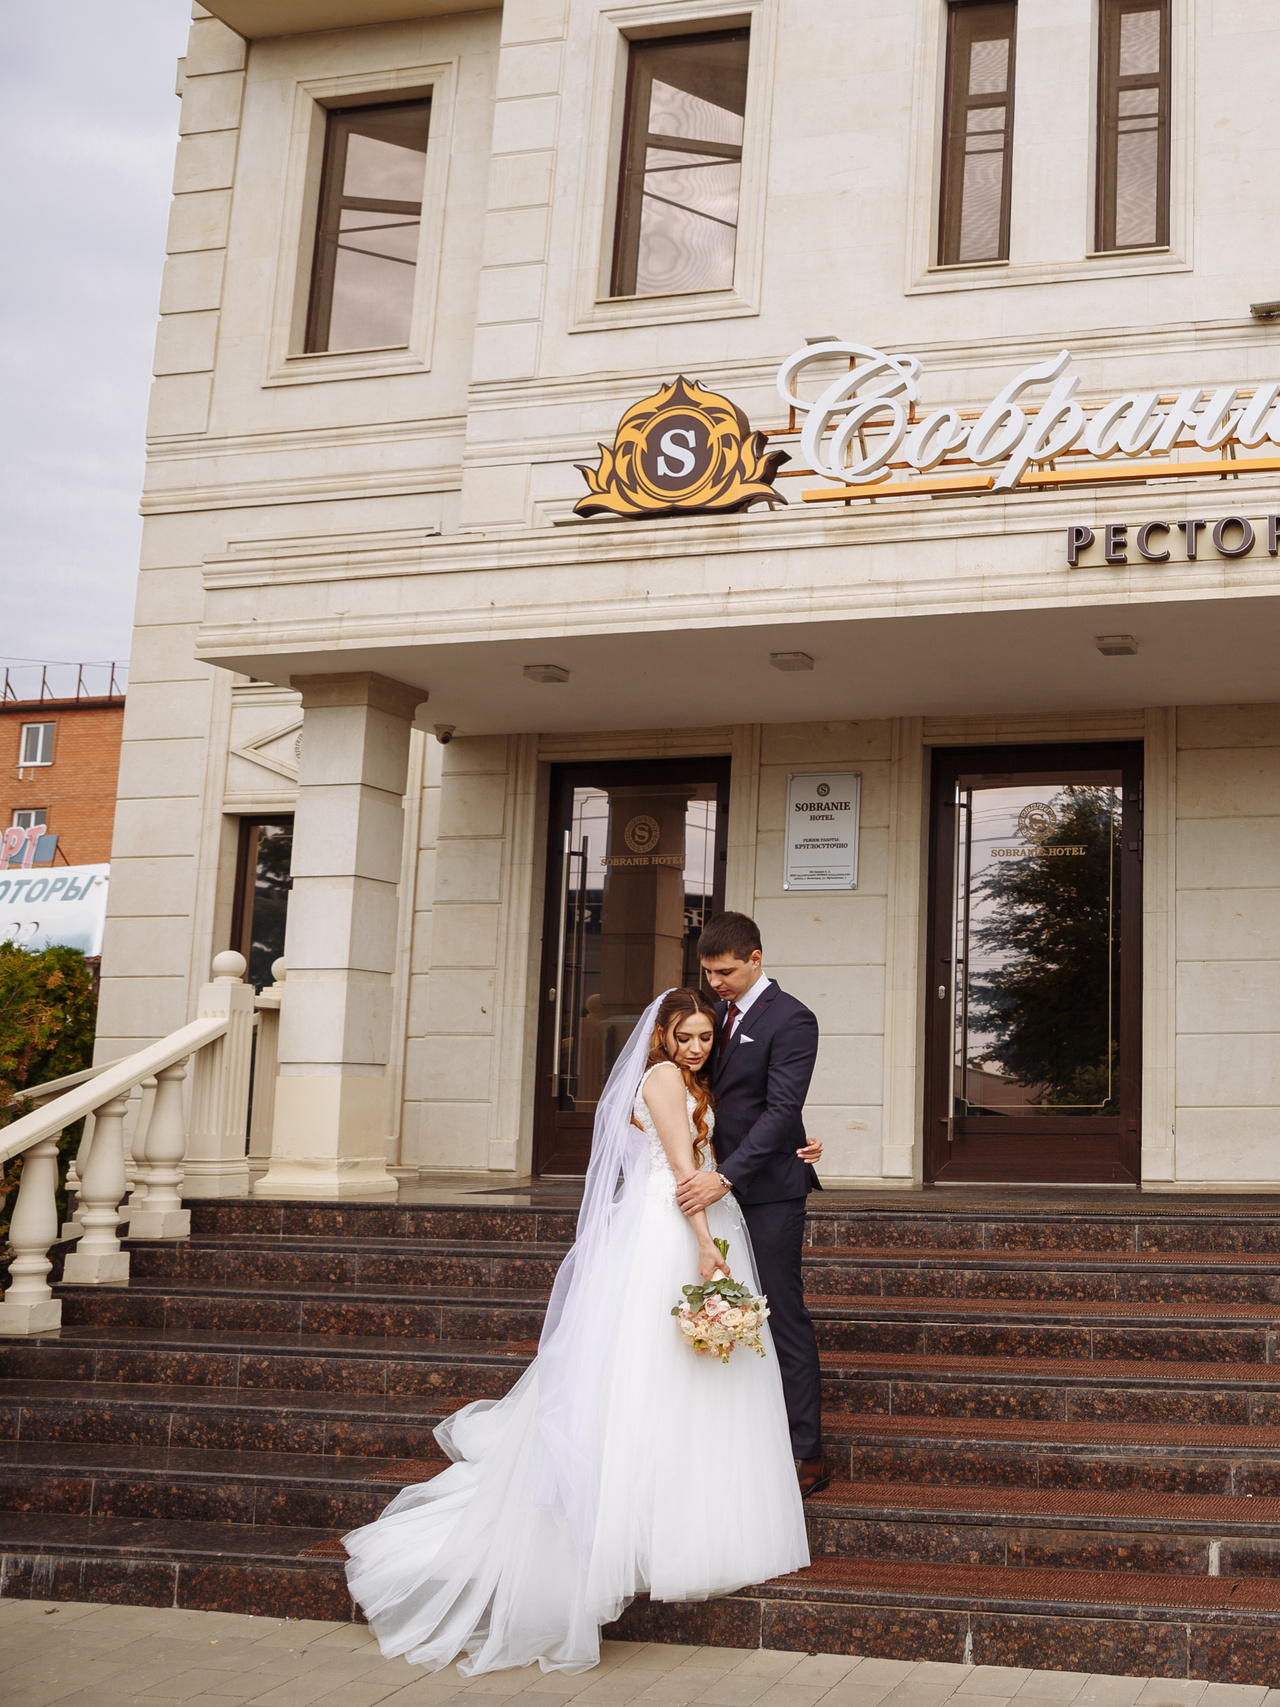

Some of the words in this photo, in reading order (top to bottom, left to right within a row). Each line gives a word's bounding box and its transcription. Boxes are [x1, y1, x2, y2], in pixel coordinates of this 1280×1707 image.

[657, 428, 697, 478] S
[795, 802, 851, 812] SOBRANIE
[1029, 813, 1047, 832] S
[634, 824, 649, 843] S
[0, 824, 47, 869] РТ
[990, 847, 1047, 857] SOBRANIE
[1048, 847, 1086, 856] HOTEL
[600, 857, 650, 866] SOBRANIE
[651, 856, 685, 865] HOTEL
